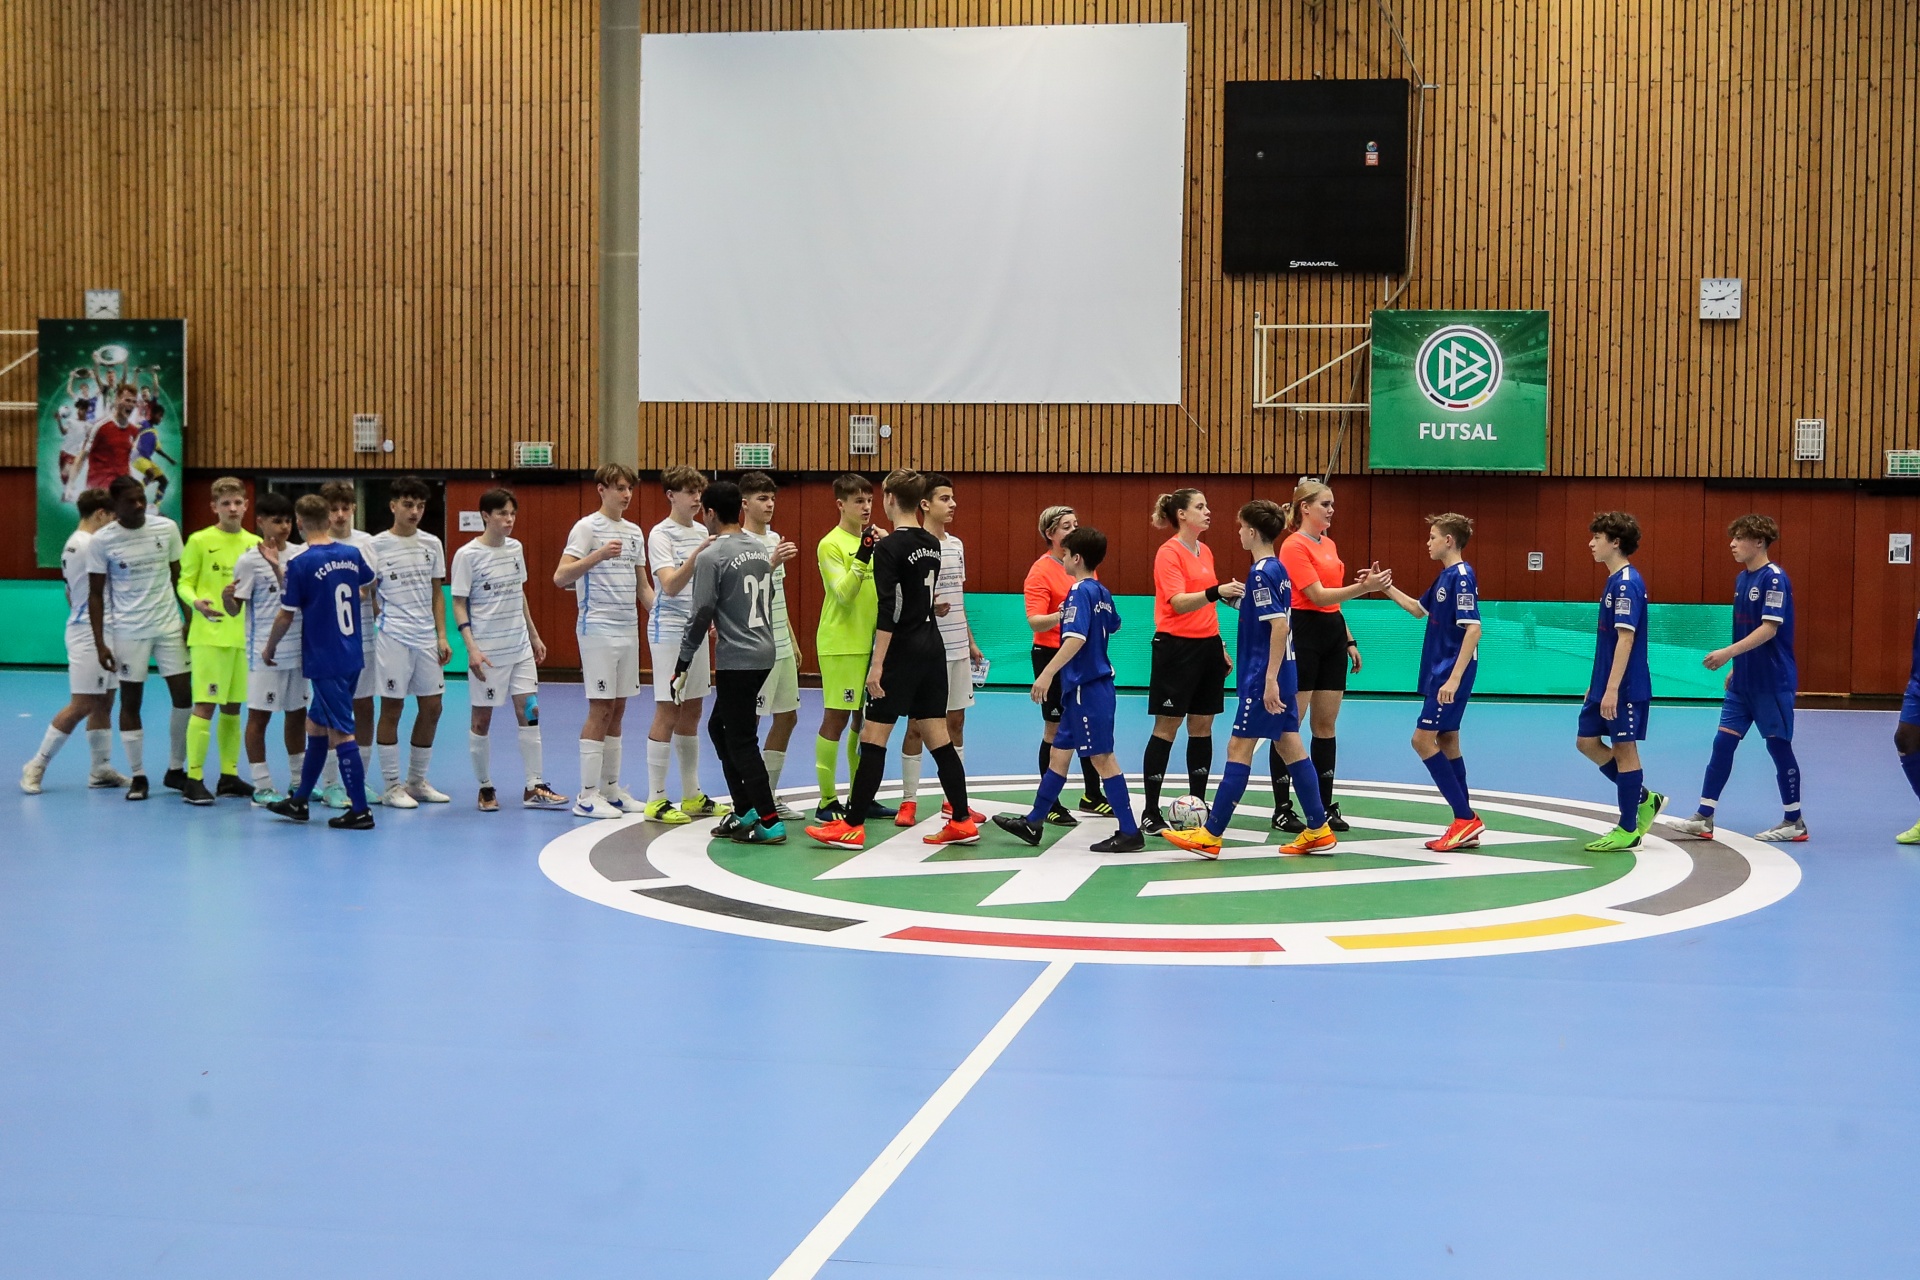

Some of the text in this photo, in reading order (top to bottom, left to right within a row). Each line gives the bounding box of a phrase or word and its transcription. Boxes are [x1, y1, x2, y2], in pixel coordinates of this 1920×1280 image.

[1419, 422, 1498, 441] FUTSAL
[730, 557, 741, 570] FC
[908, 552, 918, 565] FC
[314, 567, 327, 580] FC
[744, 572, 771, 628] 21
[924, 569, 935, 622] 1
[334, 582, 355, 636] 6
[729, 819, 741, 830] FILA
